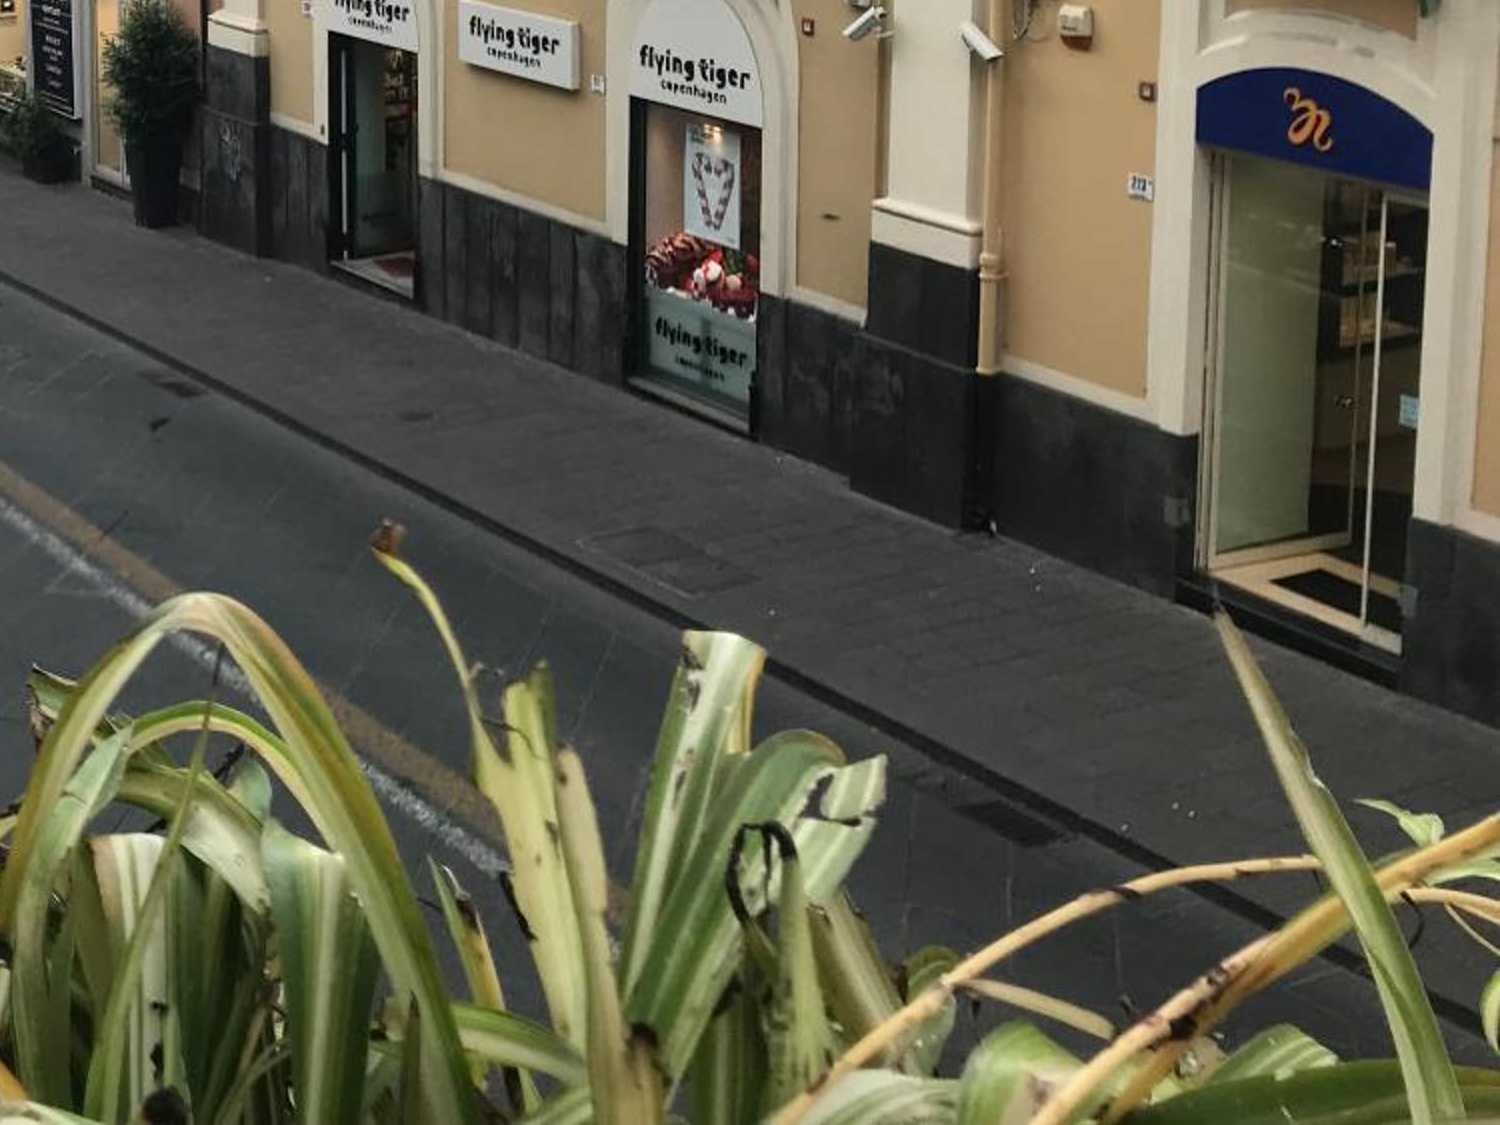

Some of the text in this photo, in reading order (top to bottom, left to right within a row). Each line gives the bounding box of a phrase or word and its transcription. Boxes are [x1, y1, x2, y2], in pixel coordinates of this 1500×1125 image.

[469, 14, 560, 55] flying tiger
[487, 46, 541, 68] copenhagen
[640, 44, 750, 90] flying tiger
[661, 79, 727, 104] copenhagen
[656, 316, 748, 367] flying tiger
